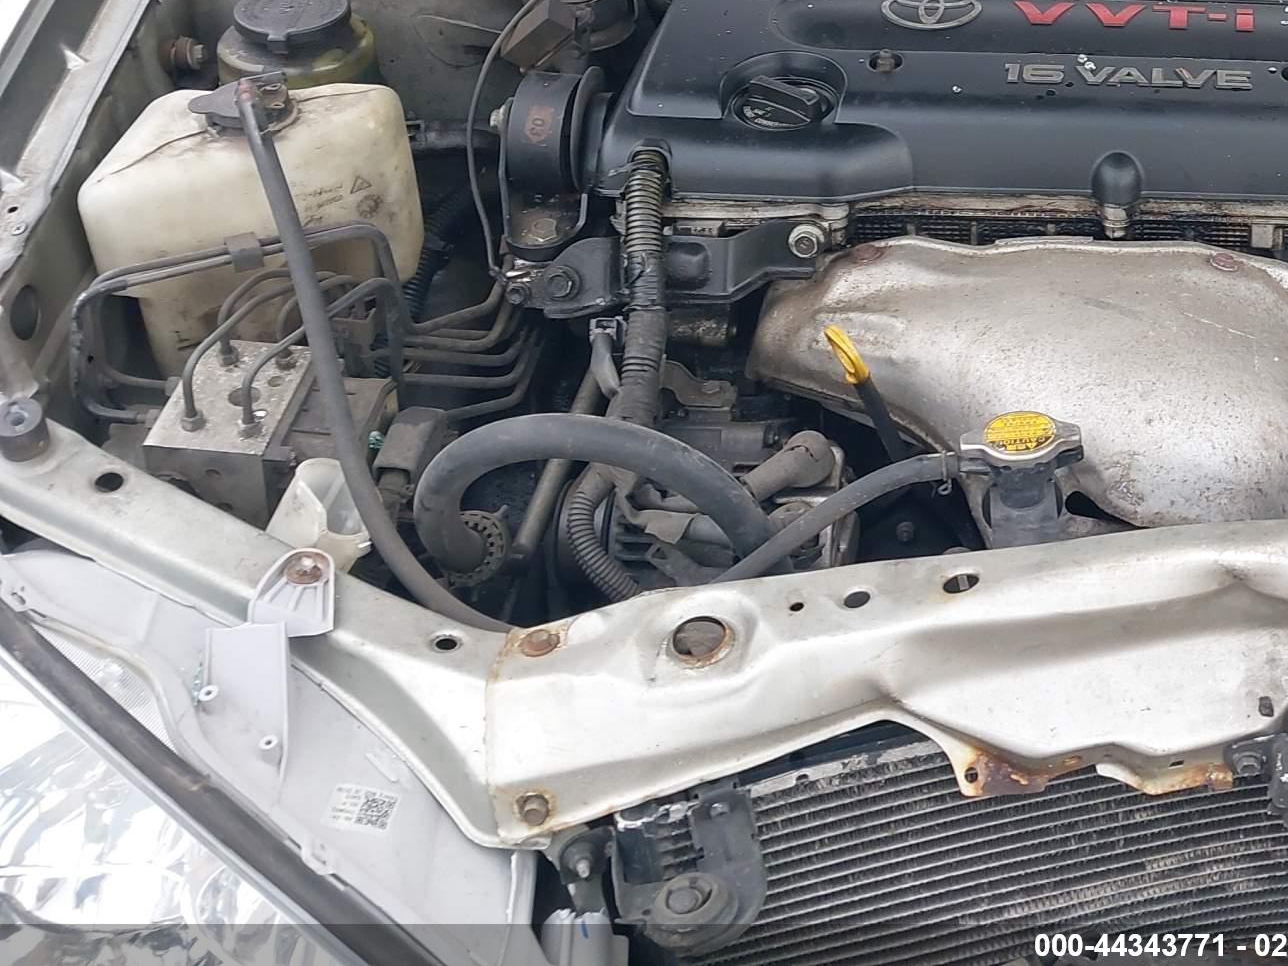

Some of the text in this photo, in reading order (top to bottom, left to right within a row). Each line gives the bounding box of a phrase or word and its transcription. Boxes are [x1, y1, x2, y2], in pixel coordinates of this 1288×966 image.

[1014, 0, 1254, 32] VVT-i
[1005, 63, 1252, 90] 16 VALVE
